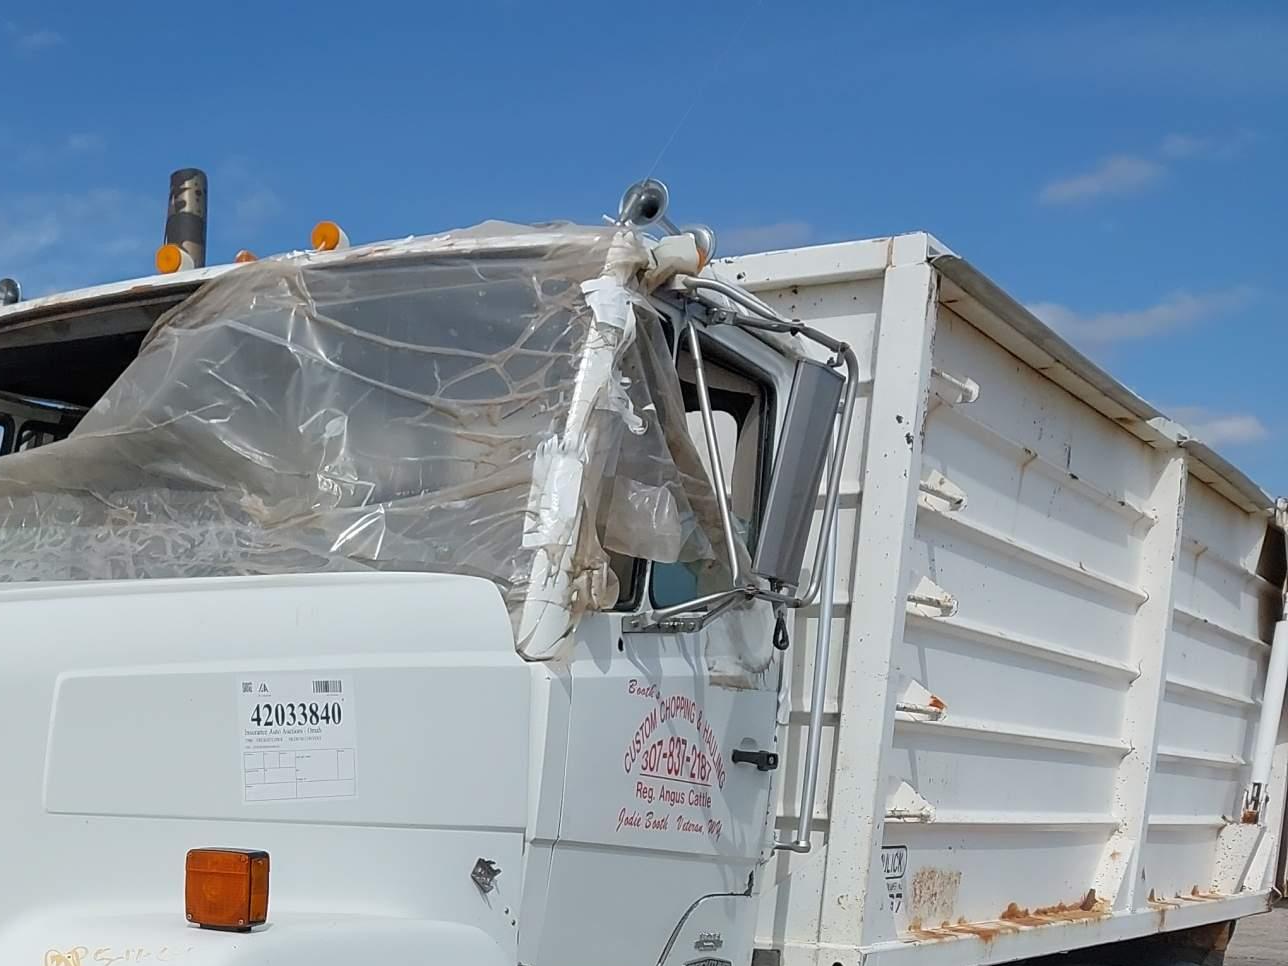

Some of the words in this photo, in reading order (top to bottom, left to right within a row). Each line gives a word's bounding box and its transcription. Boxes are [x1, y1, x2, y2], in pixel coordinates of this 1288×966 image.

[250, 702, 342, 727] 42033840
[624, 708, 658, 774] CUSTOM
[659, 696, 696, 724] CHOPPING
[696, 710, 703, 731] &
[702, 720, 727, 791] HAULING
[640, 736, 712, 782] 307-837-2187
[635, 781, 656, 804] Reg.
[658, 784, 685, 807] Angus
[687, 788, 712, 809] Cattle
[615, 807, 642, 832] Jodie
[643, 811, 670, 831] Booth
